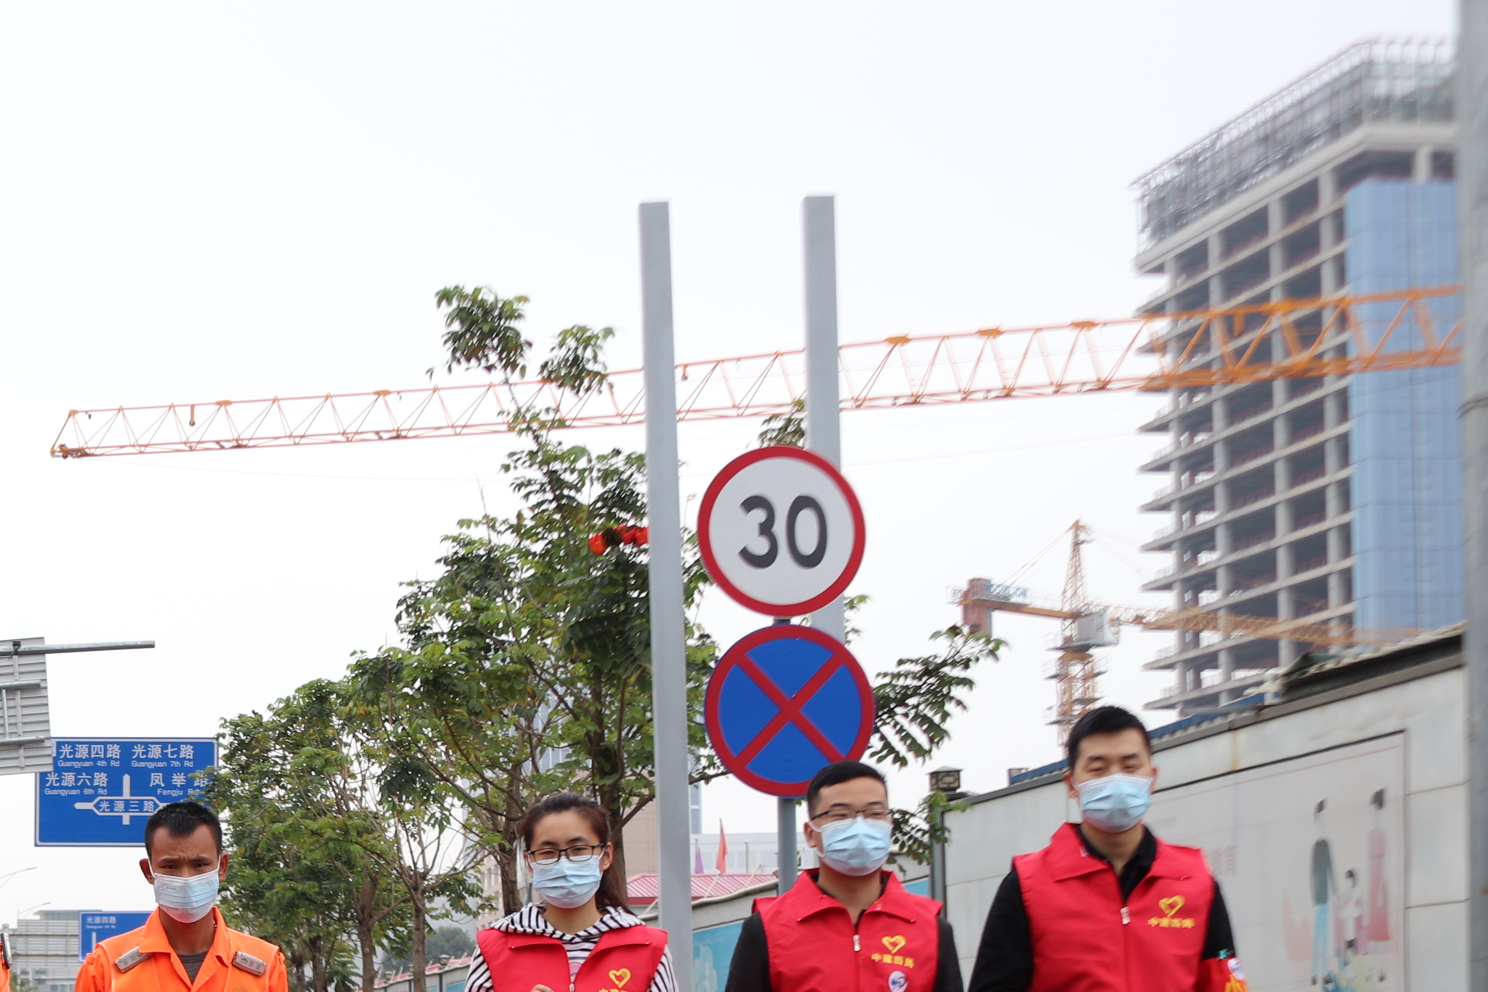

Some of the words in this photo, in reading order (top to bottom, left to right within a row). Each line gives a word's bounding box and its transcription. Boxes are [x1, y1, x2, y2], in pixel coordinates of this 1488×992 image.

[738, 495, 828, 569] 30
[59, 744, 121, 759] 光源四路
[132, 744, 194, 759] 光源七路
[58, 760, 93, 768] Guangyuan
[131, 761, 167, 769] Guangyuan
[45, 772, 108, 787] 光源六路
[44, 788, 80, 796] Guangyuan
[157, 789, 183, 797] Fengju
[99, 800, 155, 813] 光源三路
[86, 916, 117, 924] 光源四路
